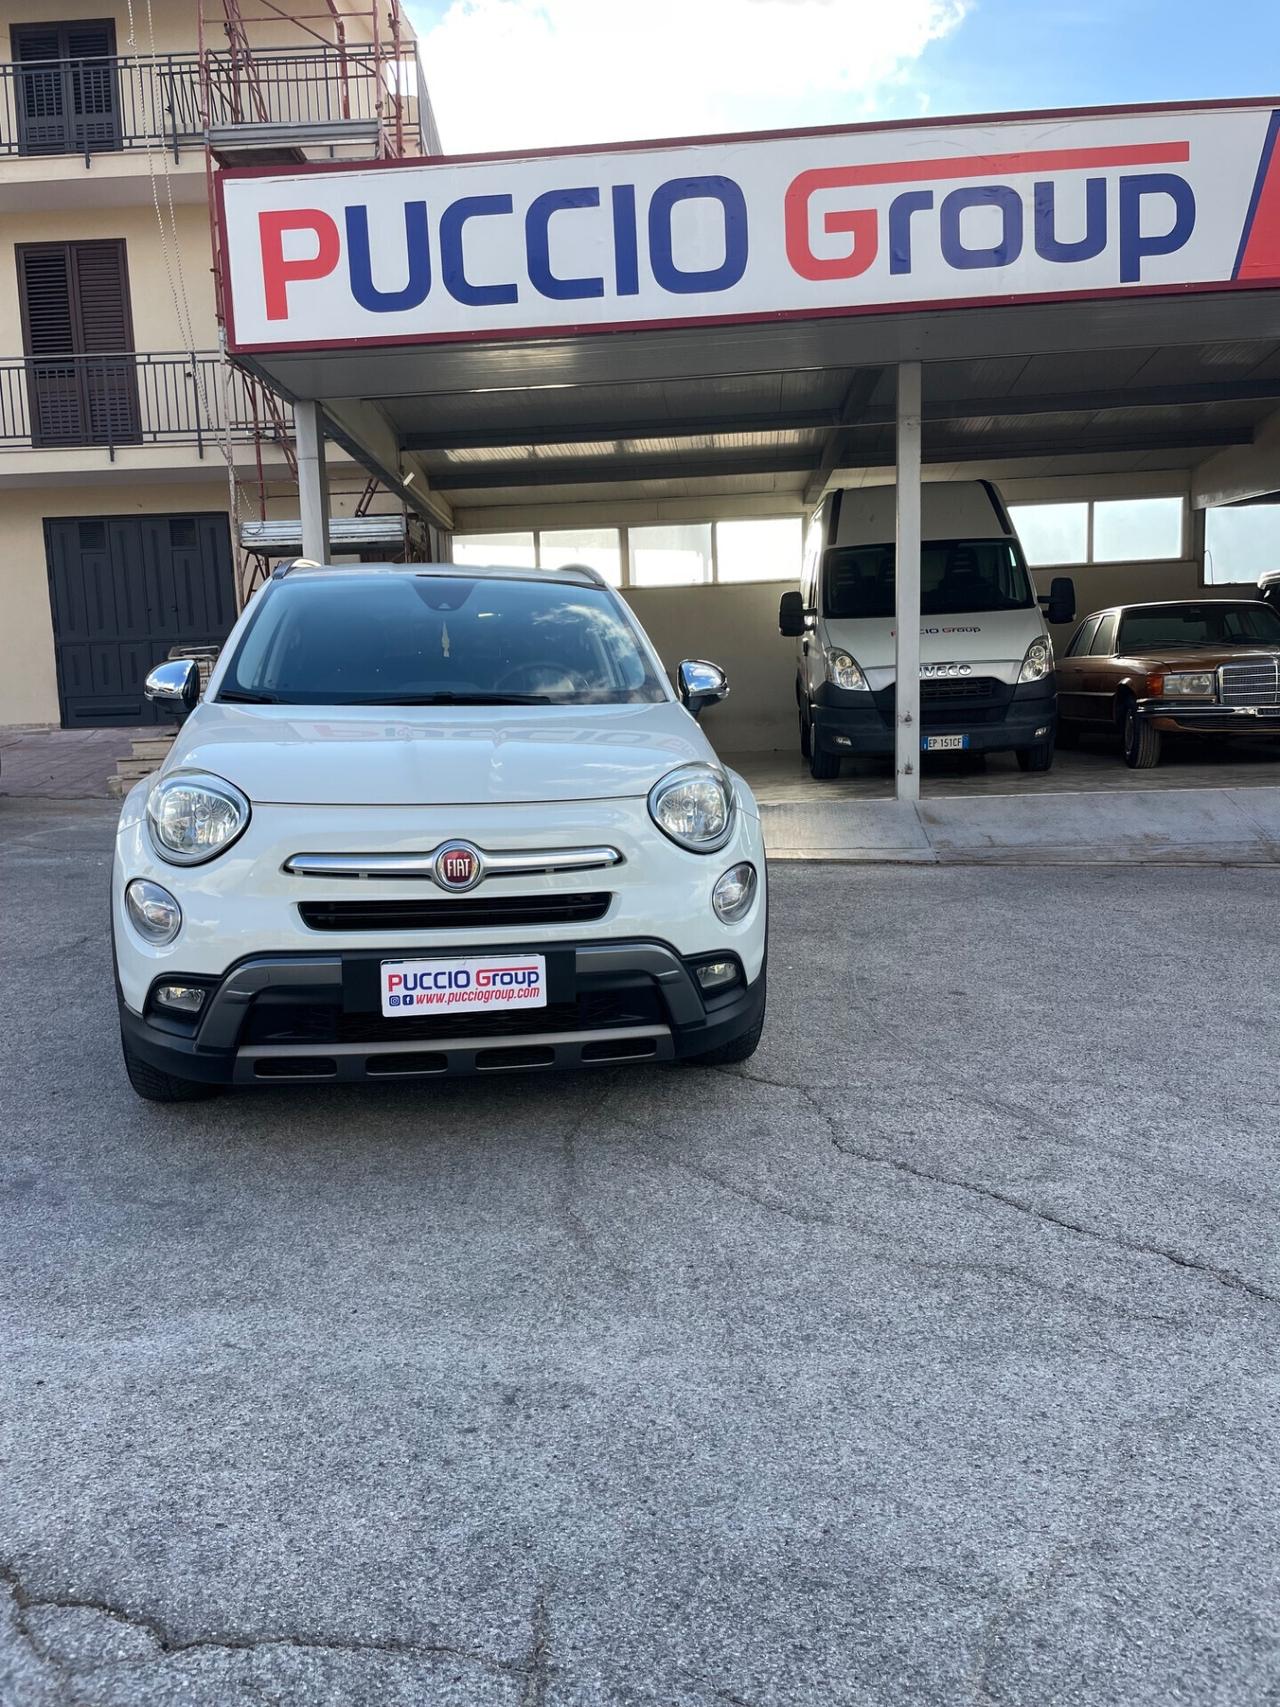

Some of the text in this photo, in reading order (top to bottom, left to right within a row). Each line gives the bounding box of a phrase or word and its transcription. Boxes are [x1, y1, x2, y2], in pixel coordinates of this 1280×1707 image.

[258, 140, 1196, 321] PUCCIO Group
[447, 858, 470, 877] FIAT
[388, 966, 540, 992] PUCCIO Group
[416, 987, 540, 1005] www.pucciogroup.com
